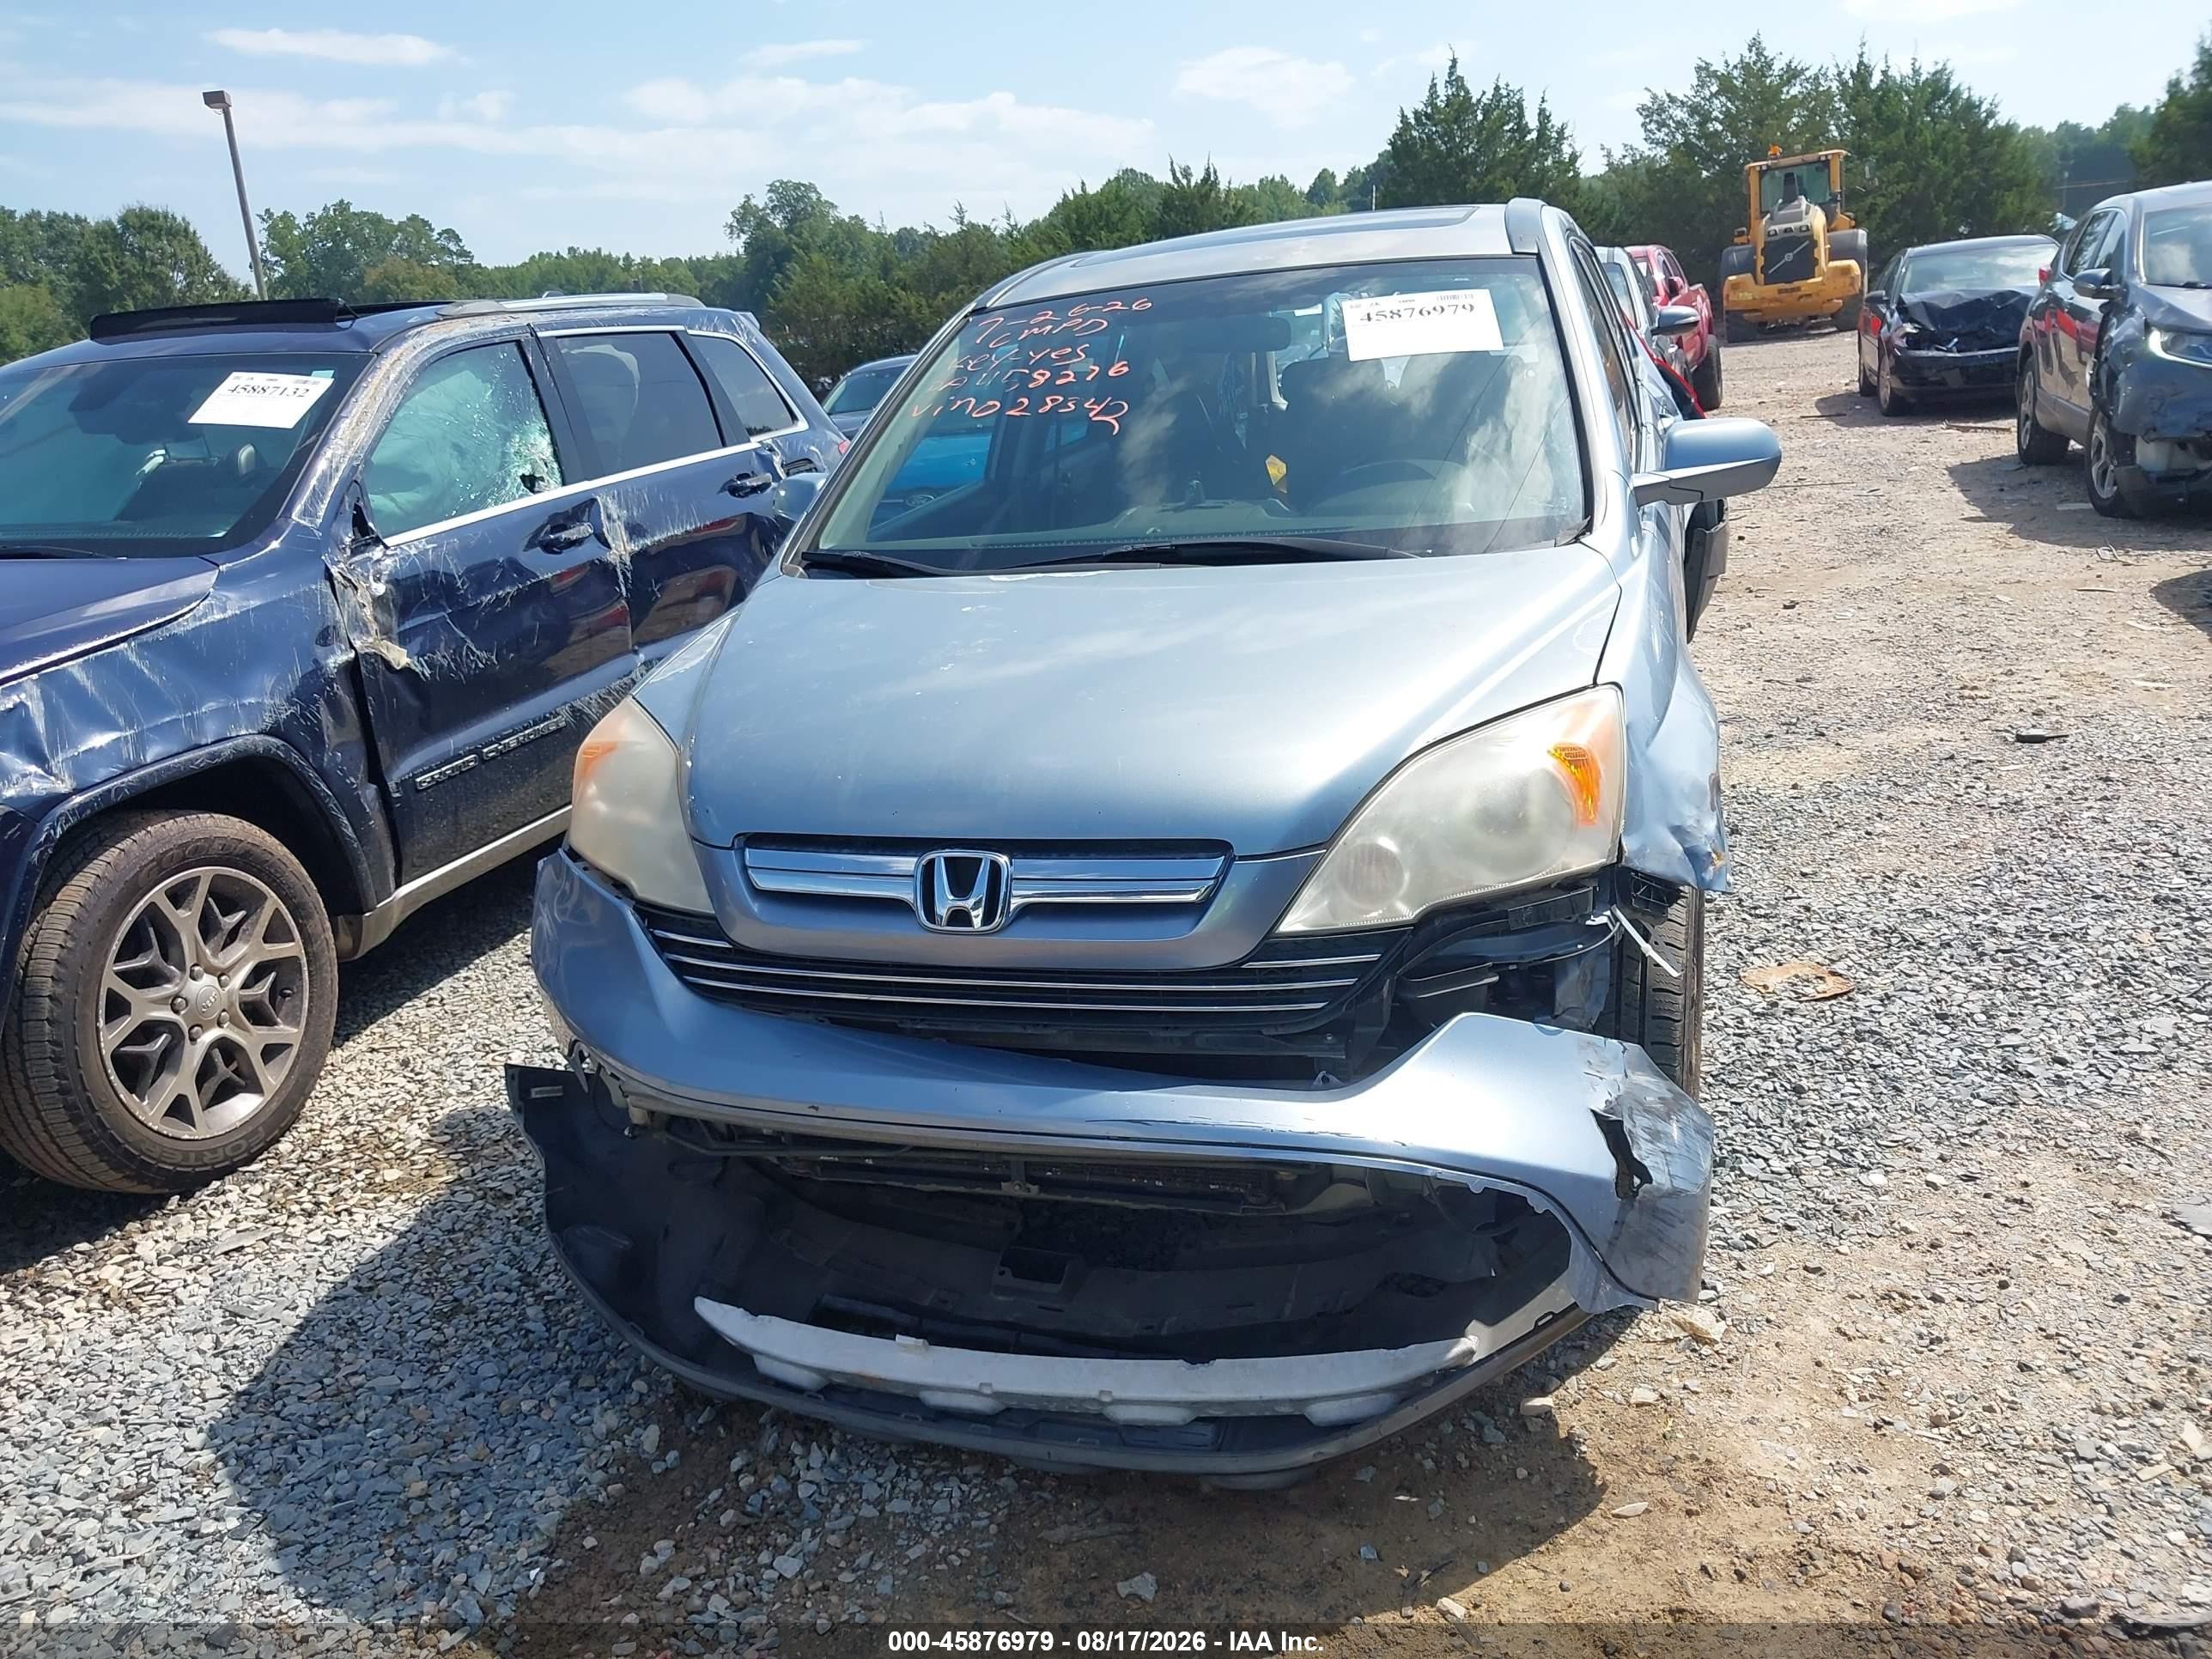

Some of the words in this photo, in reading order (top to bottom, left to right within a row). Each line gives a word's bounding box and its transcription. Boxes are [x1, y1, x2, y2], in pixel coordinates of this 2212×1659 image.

[1359, 302, 1475, 322] 45876979
[227, 384, 310, 398] 45887132
[415, 753, 479, 791] GRAND
